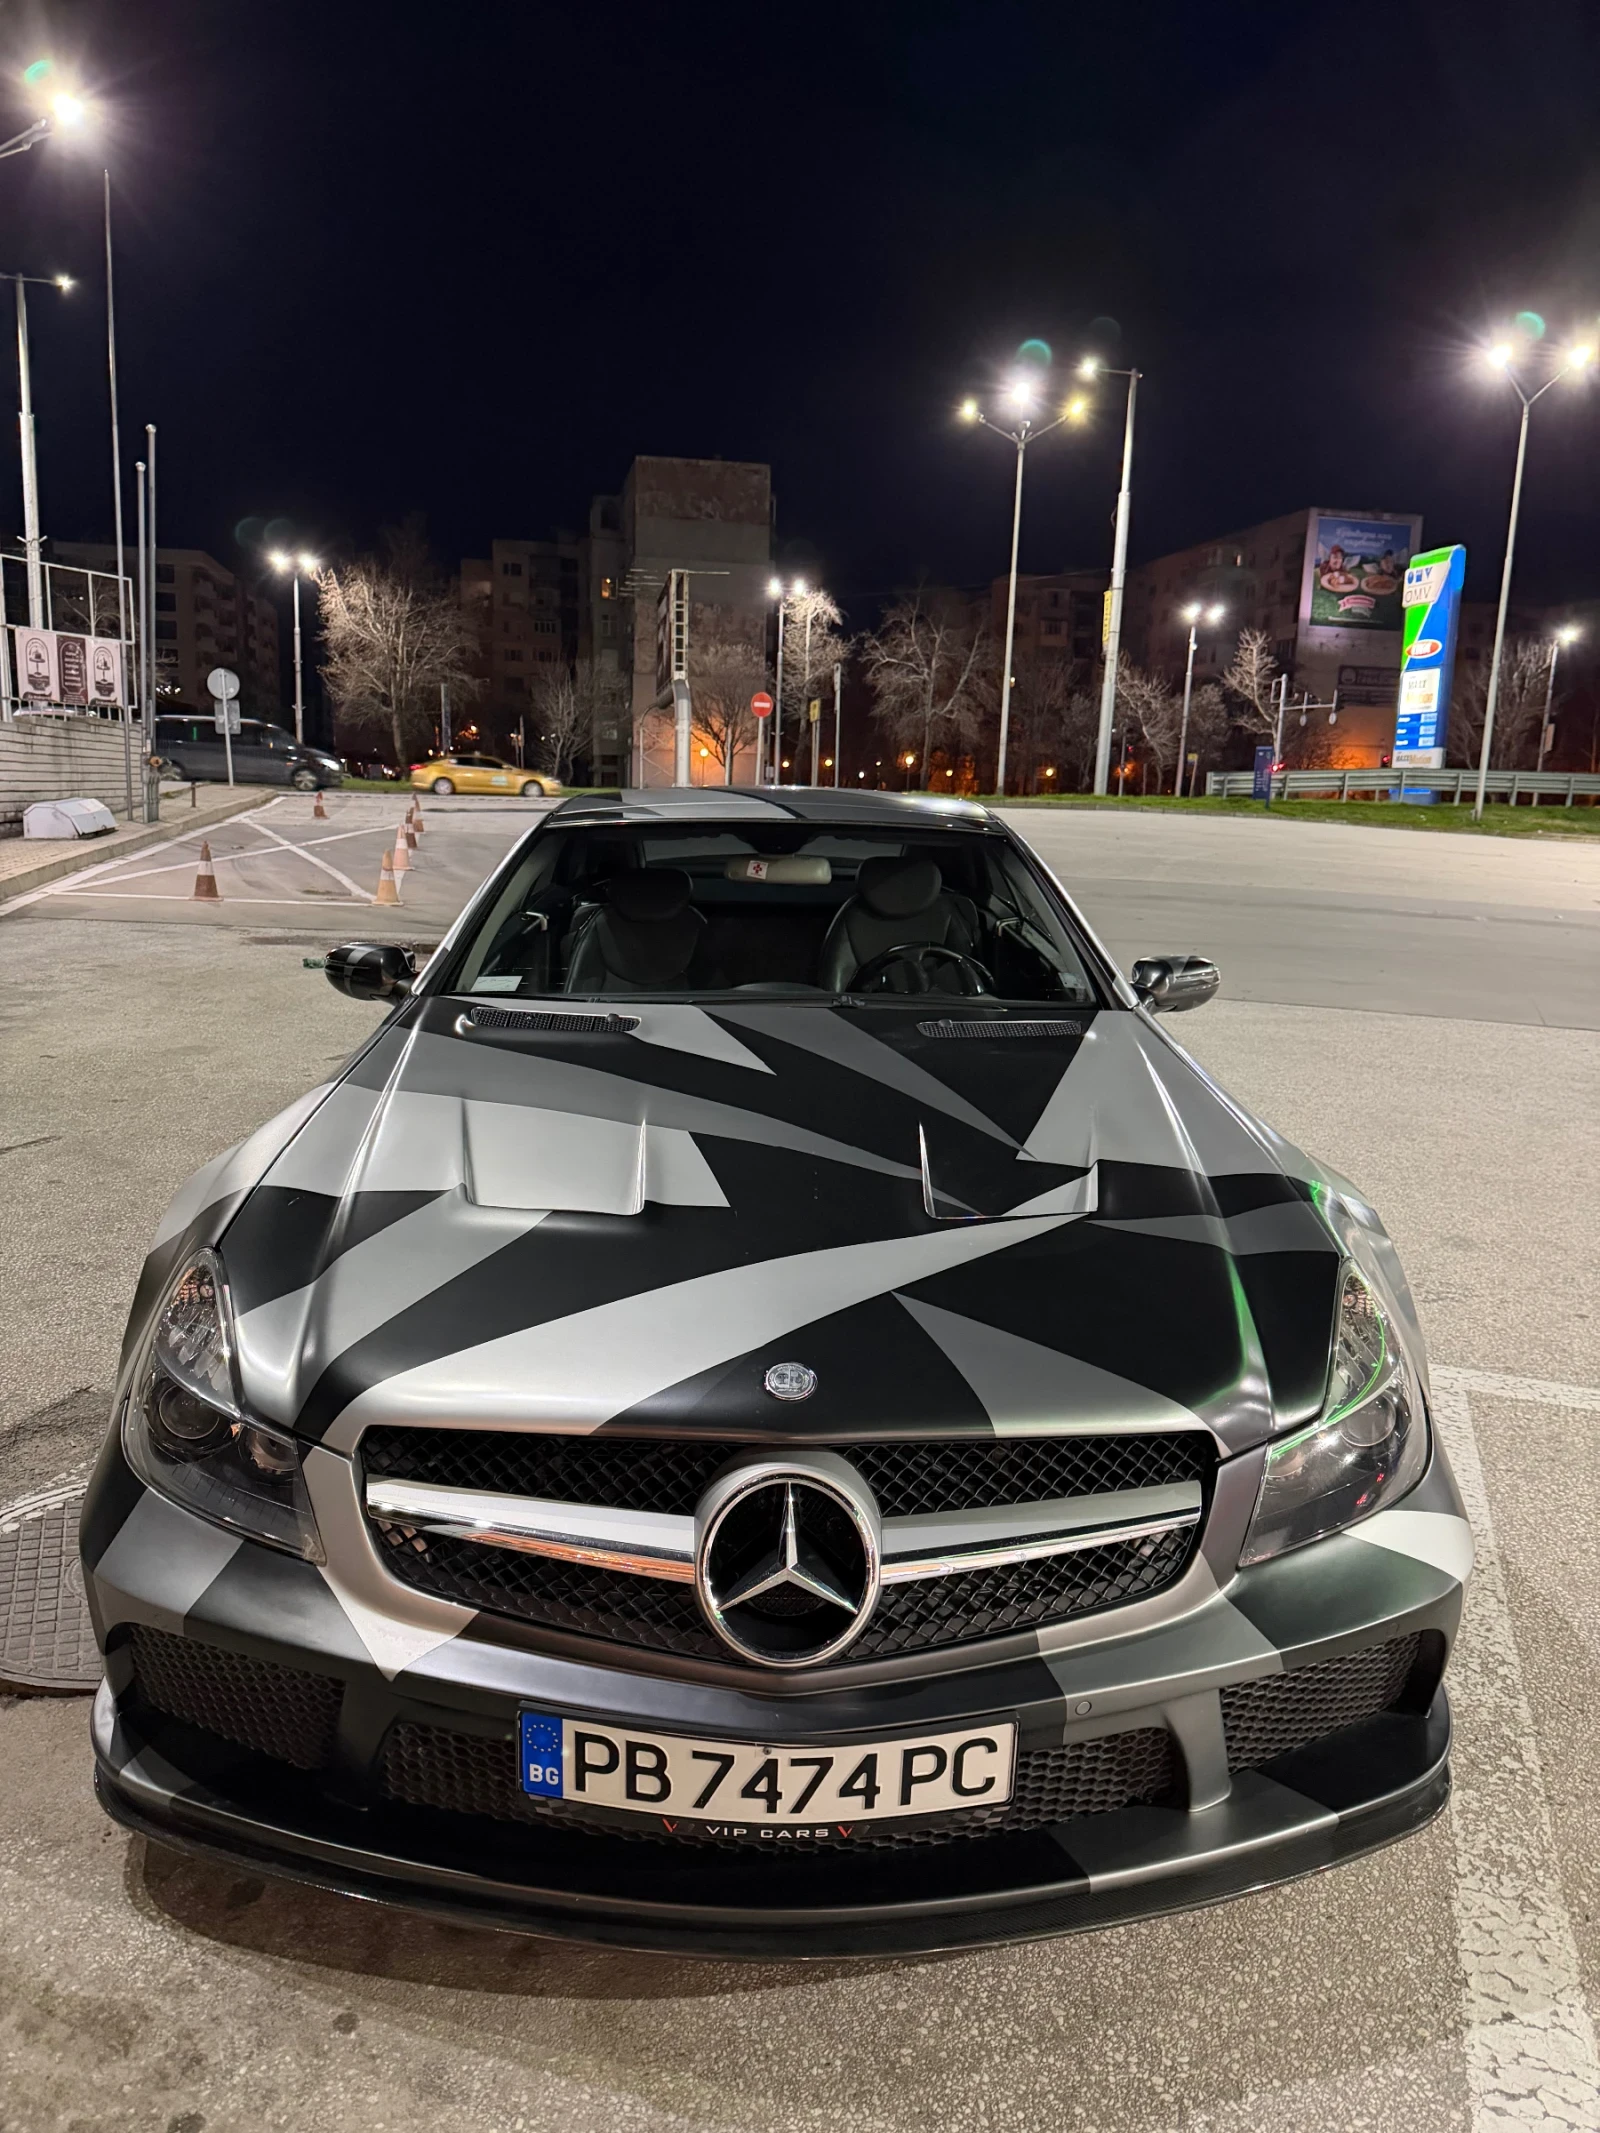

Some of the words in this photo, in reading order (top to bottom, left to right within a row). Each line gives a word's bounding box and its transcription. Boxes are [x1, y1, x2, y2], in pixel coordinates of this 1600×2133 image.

[1404, 586, 1432, 603] OMV
[529, 1763, 559, 1785] BG
[574, 1730, 672, 1803] PB
[691, 1750, 881, 1814] 7474
[899, 1737, 998, 1806] PC
[706, 1825, 747, 1837] VIP
[760, 1828, 829, 1839] CARS
